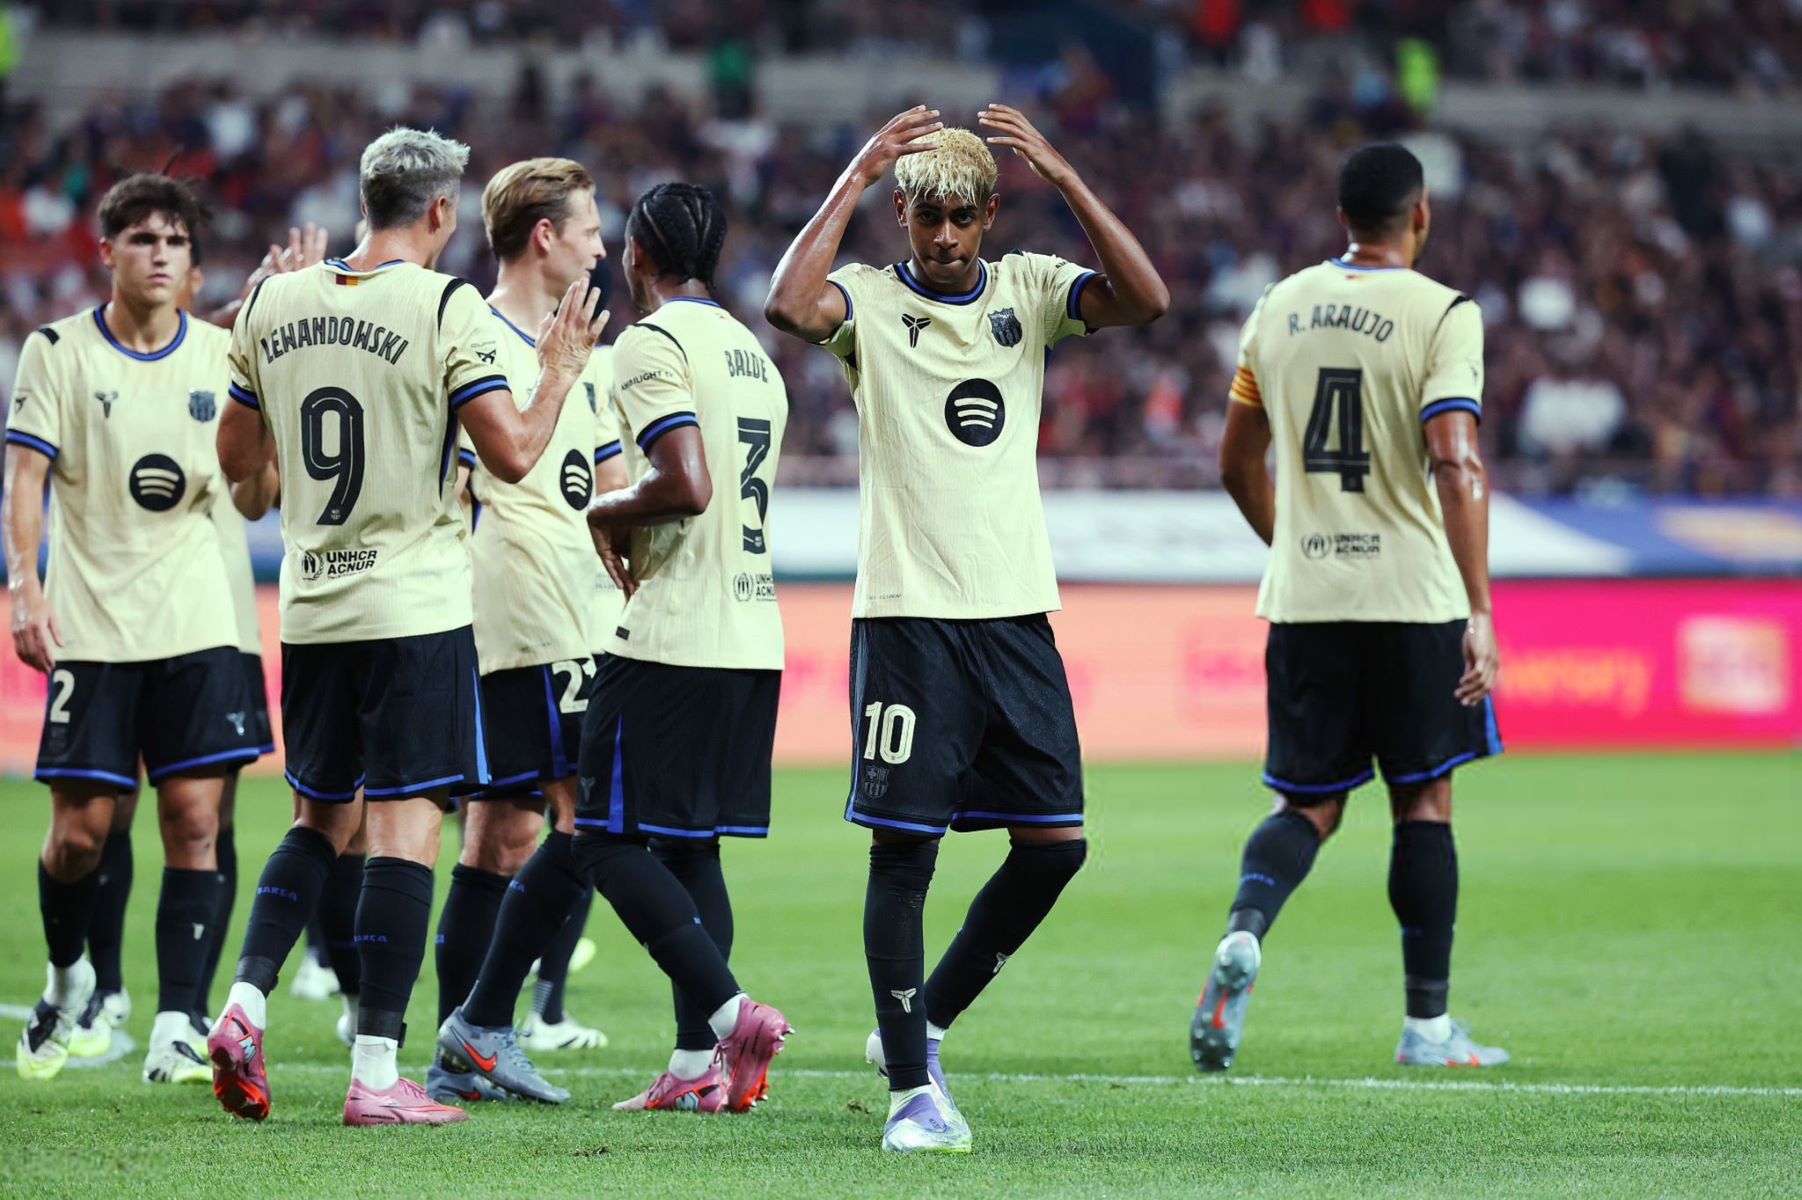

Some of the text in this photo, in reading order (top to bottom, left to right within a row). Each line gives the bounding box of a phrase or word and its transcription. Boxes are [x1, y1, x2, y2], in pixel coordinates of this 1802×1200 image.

[260, 316, 409, 365] LEWANDOWSKI
[1311, 303, 1393, 342] ARAUJO
[724, 349, 767, 383] BALDE
[1303, 367, 1371, 492] 4
[300, 386, 365, 526] 9
[737, 416, 771, 555] 3
[326, 550, 377, 563] UNHCR
[328, 560, 375, 575] ACNUR
[50, 669, 75, 723] 2
[863, 700, 917, 765] 10
